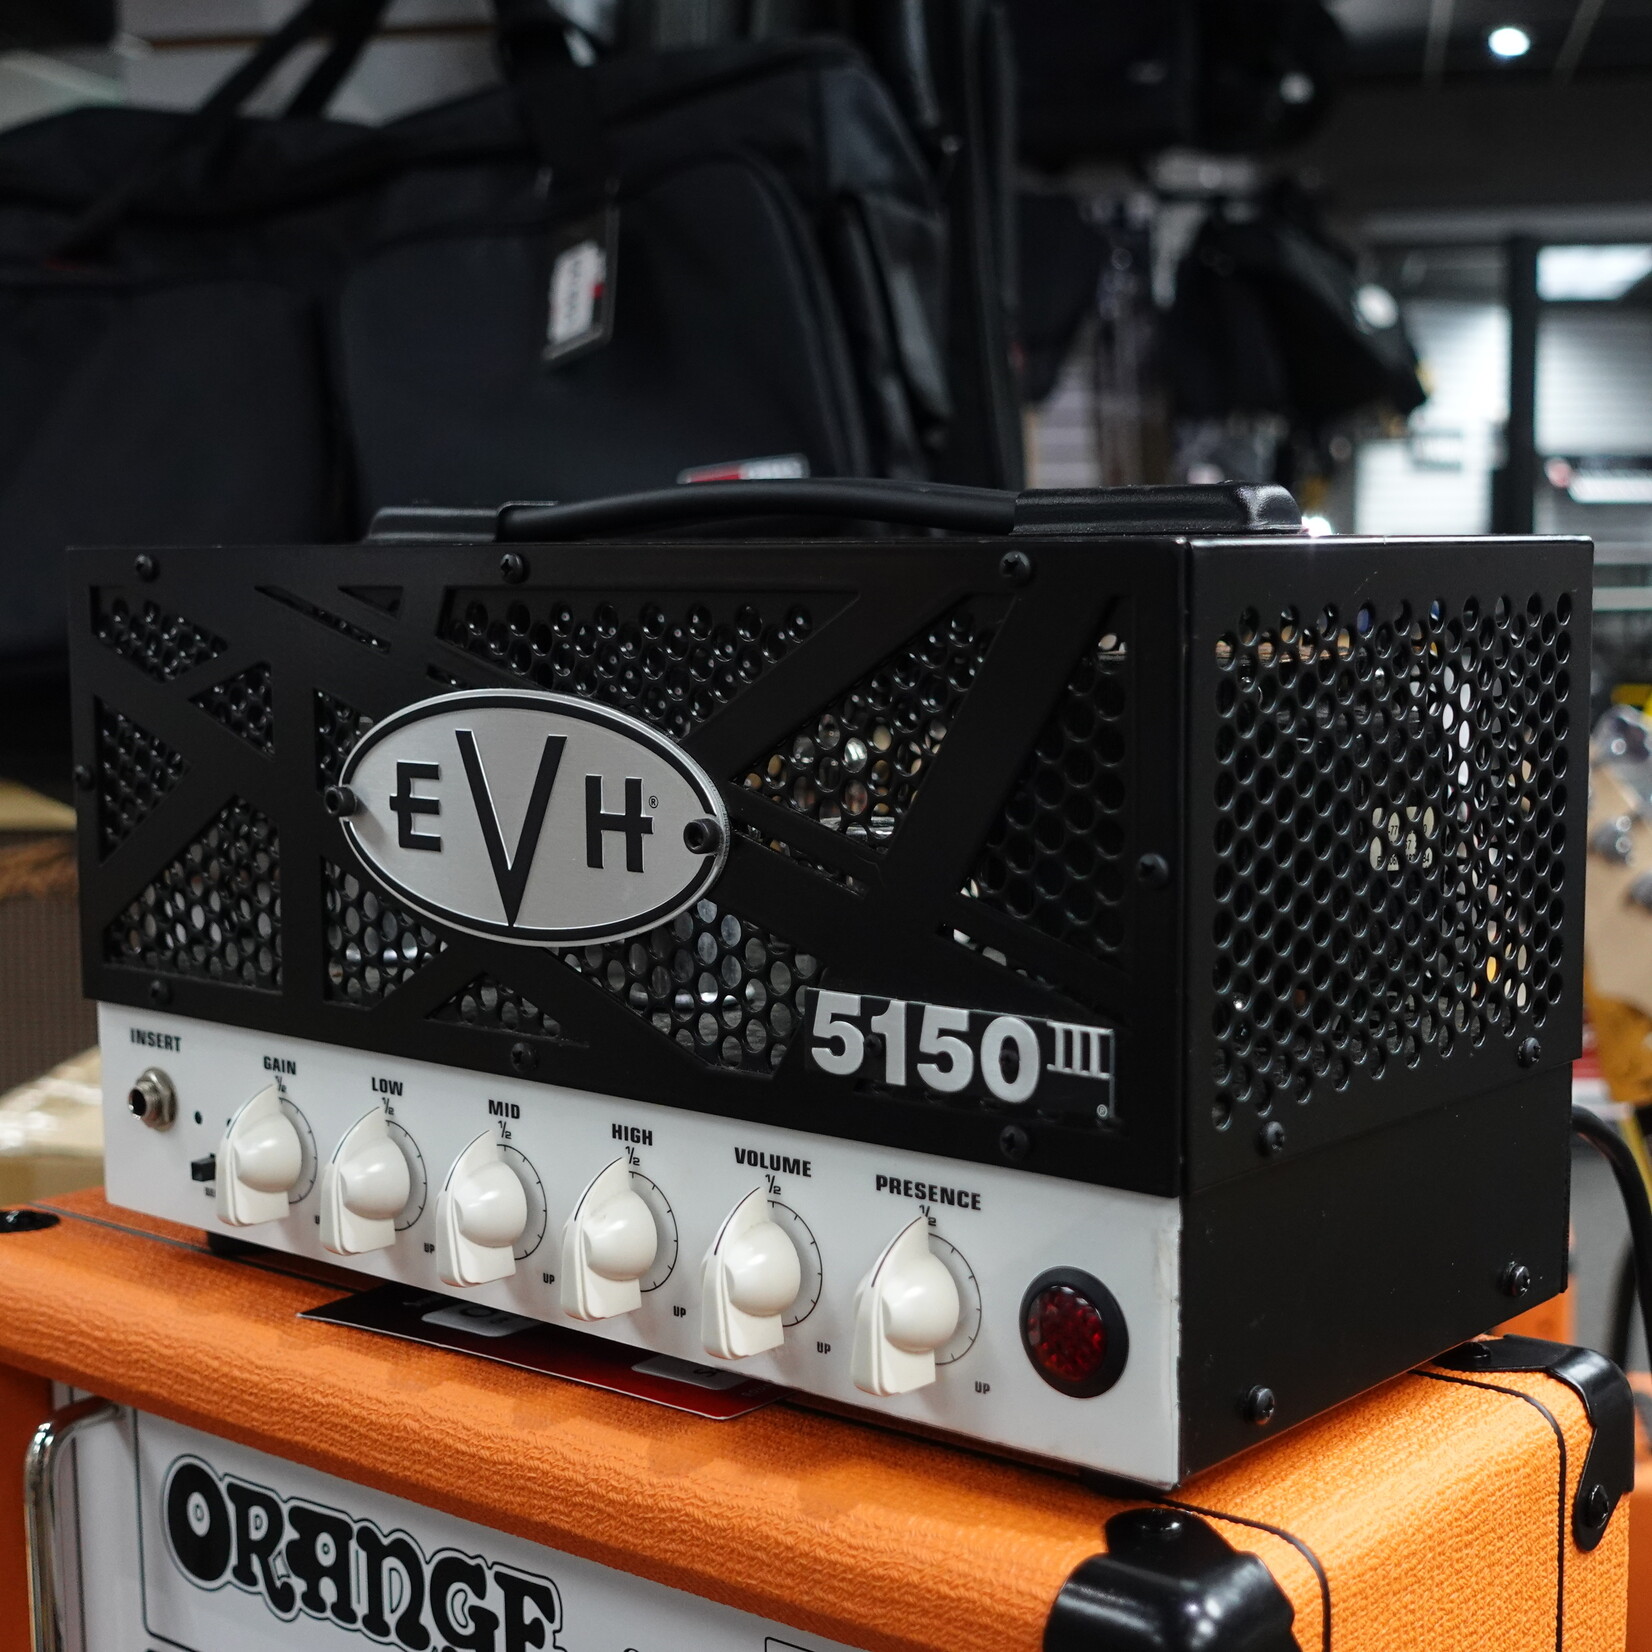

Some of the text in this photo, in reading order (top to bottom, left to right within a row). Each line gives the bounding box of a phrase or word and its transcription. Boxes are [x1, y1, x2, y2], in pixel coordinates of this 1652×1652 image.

[130, 1028, 182, 1052] INSERT
[263, 1056, 297, 1075] GAIN
[372, 1077, 403, 1096] LOW
[488, 1099, 520, 1119] MID
[612, 1123, 653, 1146] HIGH
[734, 1147, 812, 1178] VOLUME
[875, 1174, 982, 1211] PRESENCE
[423, 1243, 435, 1254] UP
[543, 1273, 555, 1285] UP
[673, 1306, 687, 1318] UP
[817, 1341, 831, 1354] UP
[975, 1381, 991, 1394] UP
